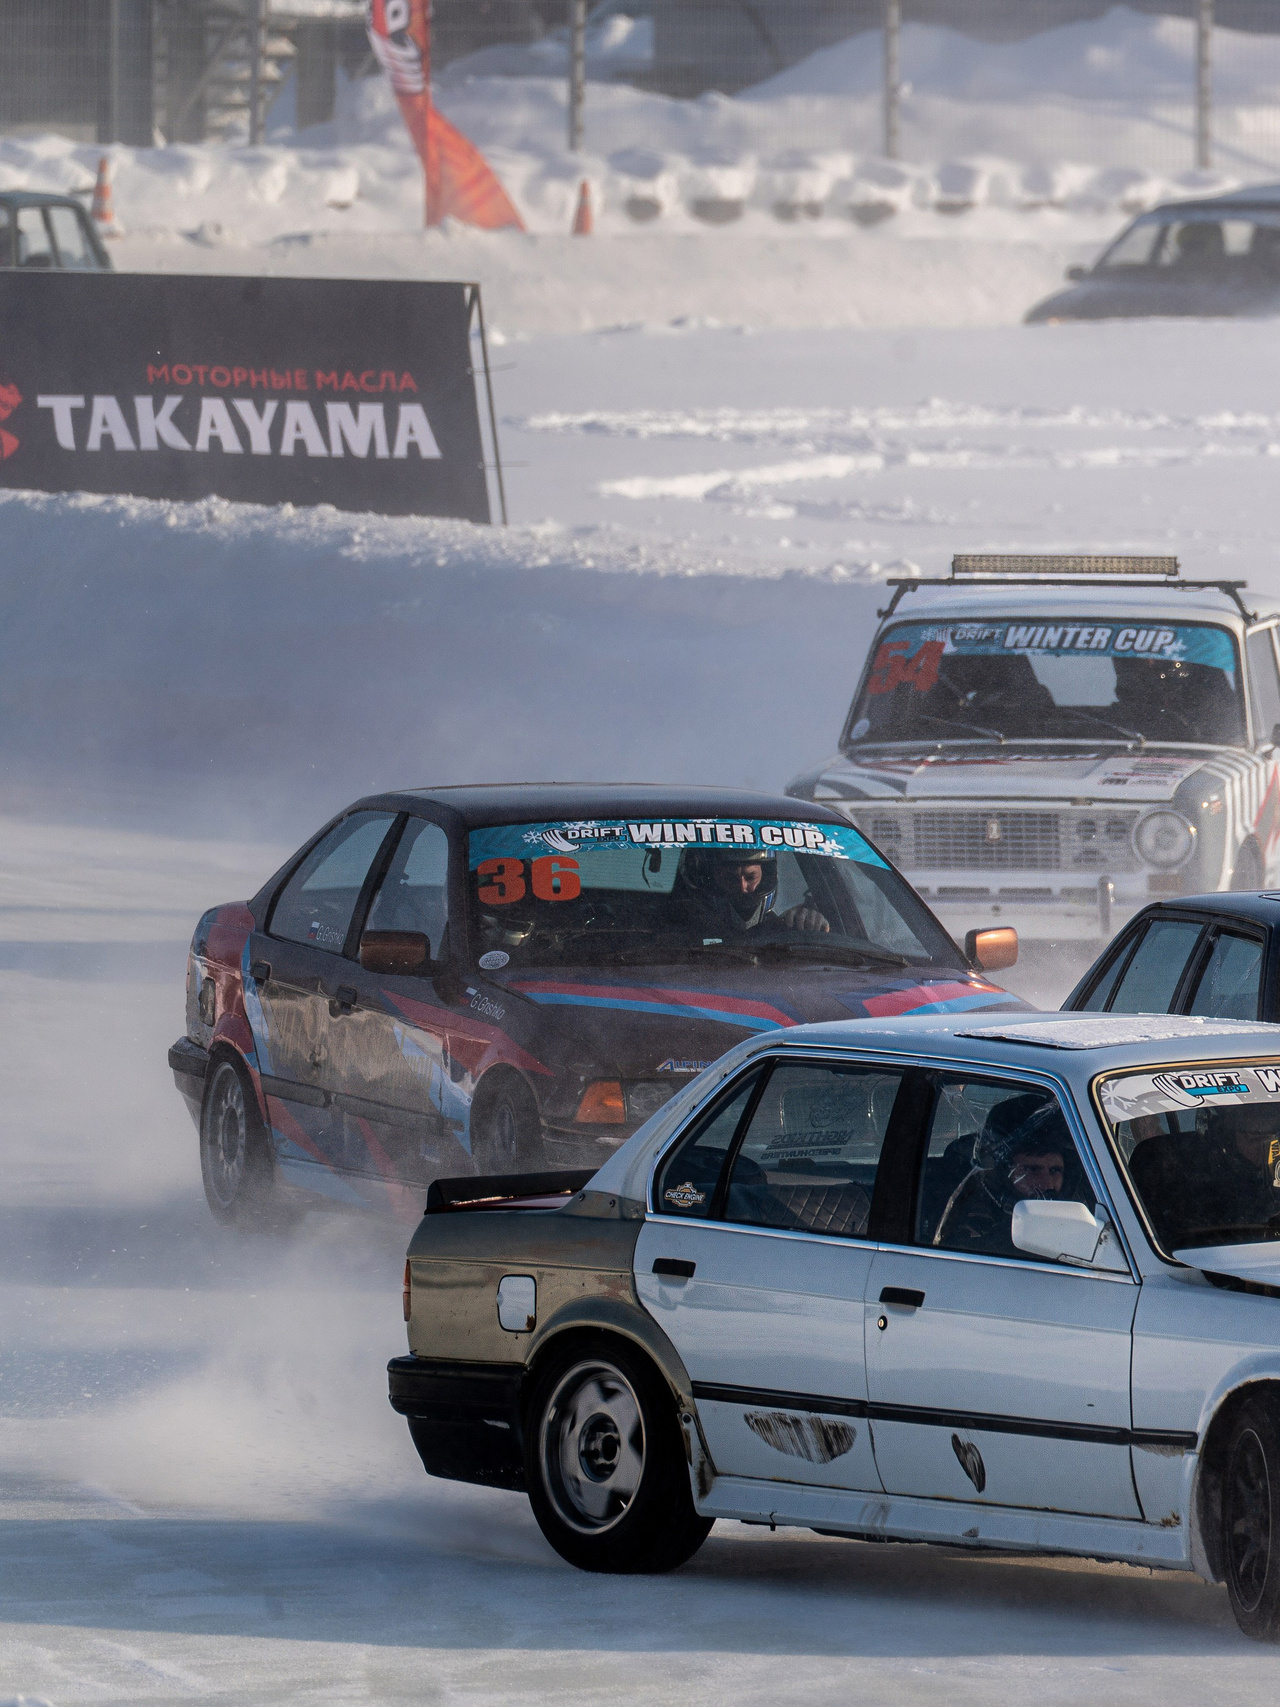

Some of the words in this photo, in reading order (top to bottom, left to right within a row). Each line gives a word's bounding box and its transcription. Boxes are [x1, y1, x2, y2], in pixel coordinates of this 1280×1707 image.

[146, 363, 308, 391] МОТОРНЫЕ
[315, 370, 418, 393] МАСЛА
[37, 394, 442, 459] TAKAYAMA
[954, 628, 1003, 641] DRIFT
[1003, 625, 1108, 651] WINTER
[1114, 627, 1176, 652] CUP
[867, 641, 945, 695] 54
[567, 827, 624, 839] DRIFT
[628, 823, 755, 843] WINTER
[760, 826, 825, 849] CUP
[477, 855, 581, 905] 36
[656, 1058, 713, 1073] ALPIN
[1183, 1072, 1241, 1089] DRIFT
[1217, 1085, 1242, 1094] EXPO
[665, 1191, 684, 1200] CHECK
[684, 1192, 705, 1202] ENGINE
